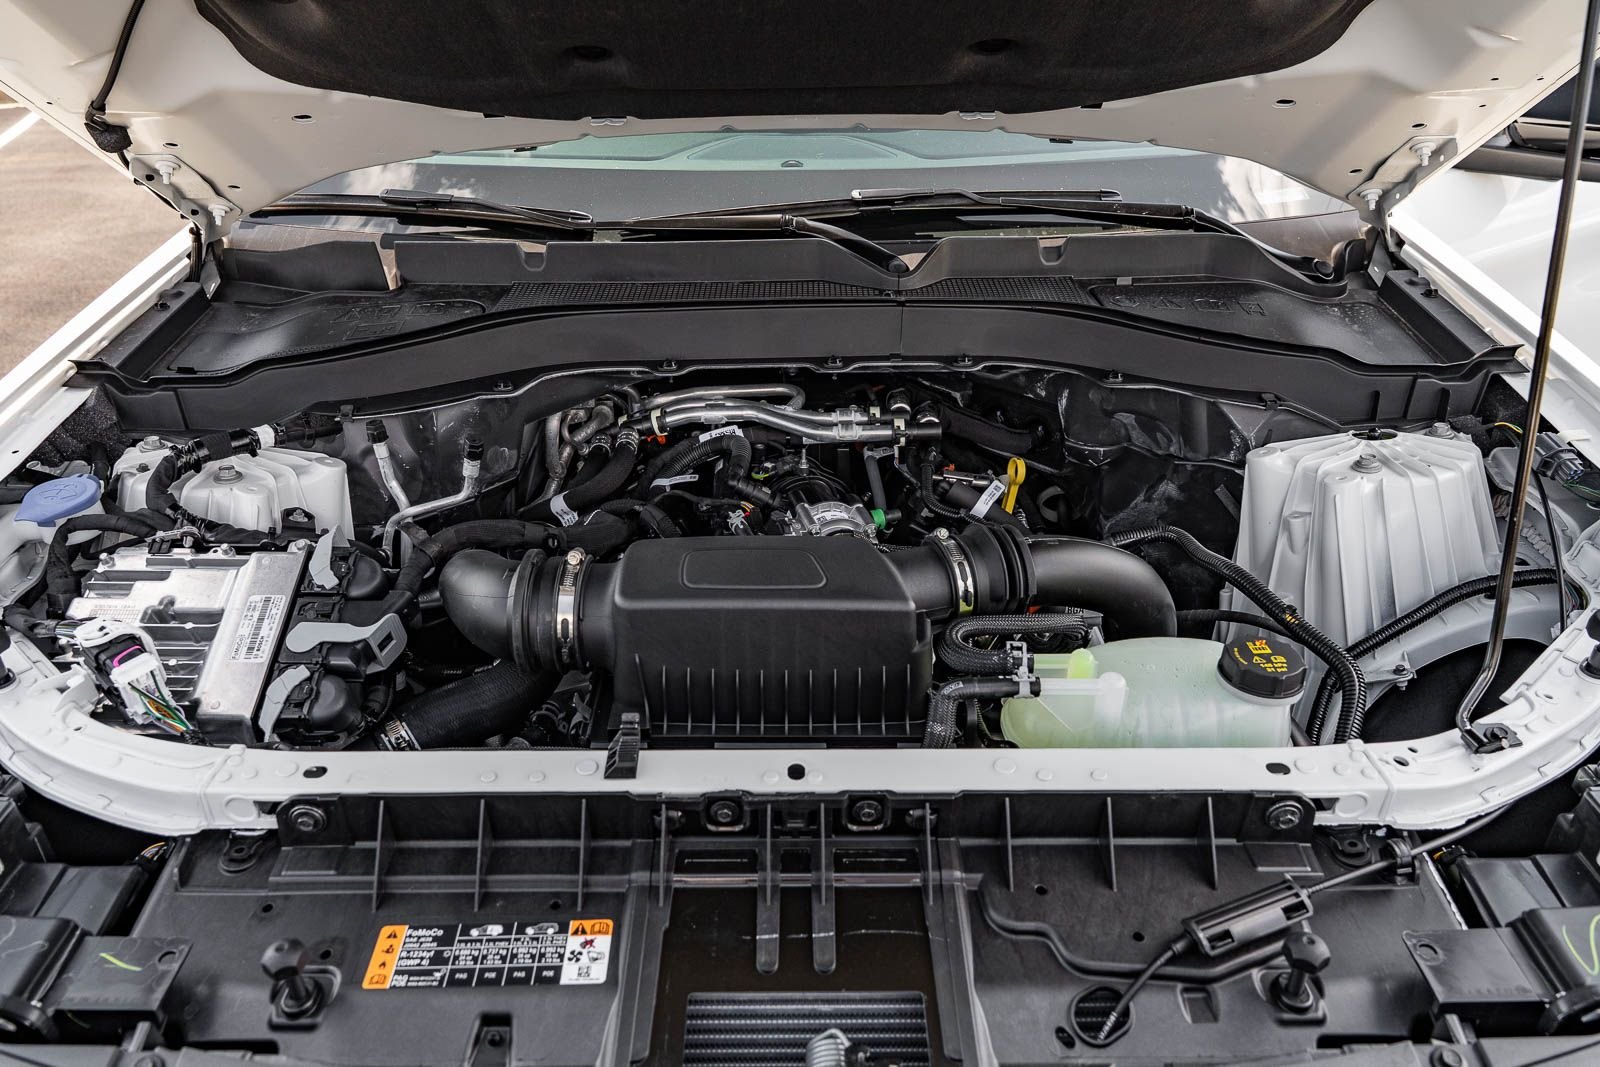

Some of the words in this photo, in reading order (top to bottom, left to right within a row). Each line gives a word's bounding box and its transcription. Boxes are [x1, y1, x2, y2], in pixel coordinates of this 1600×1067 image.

[255, 635, 265, 652] BOSCH
[407, 928, 444, 937] FoMoCo
[400, 950, 435, 958] R-1234yf
